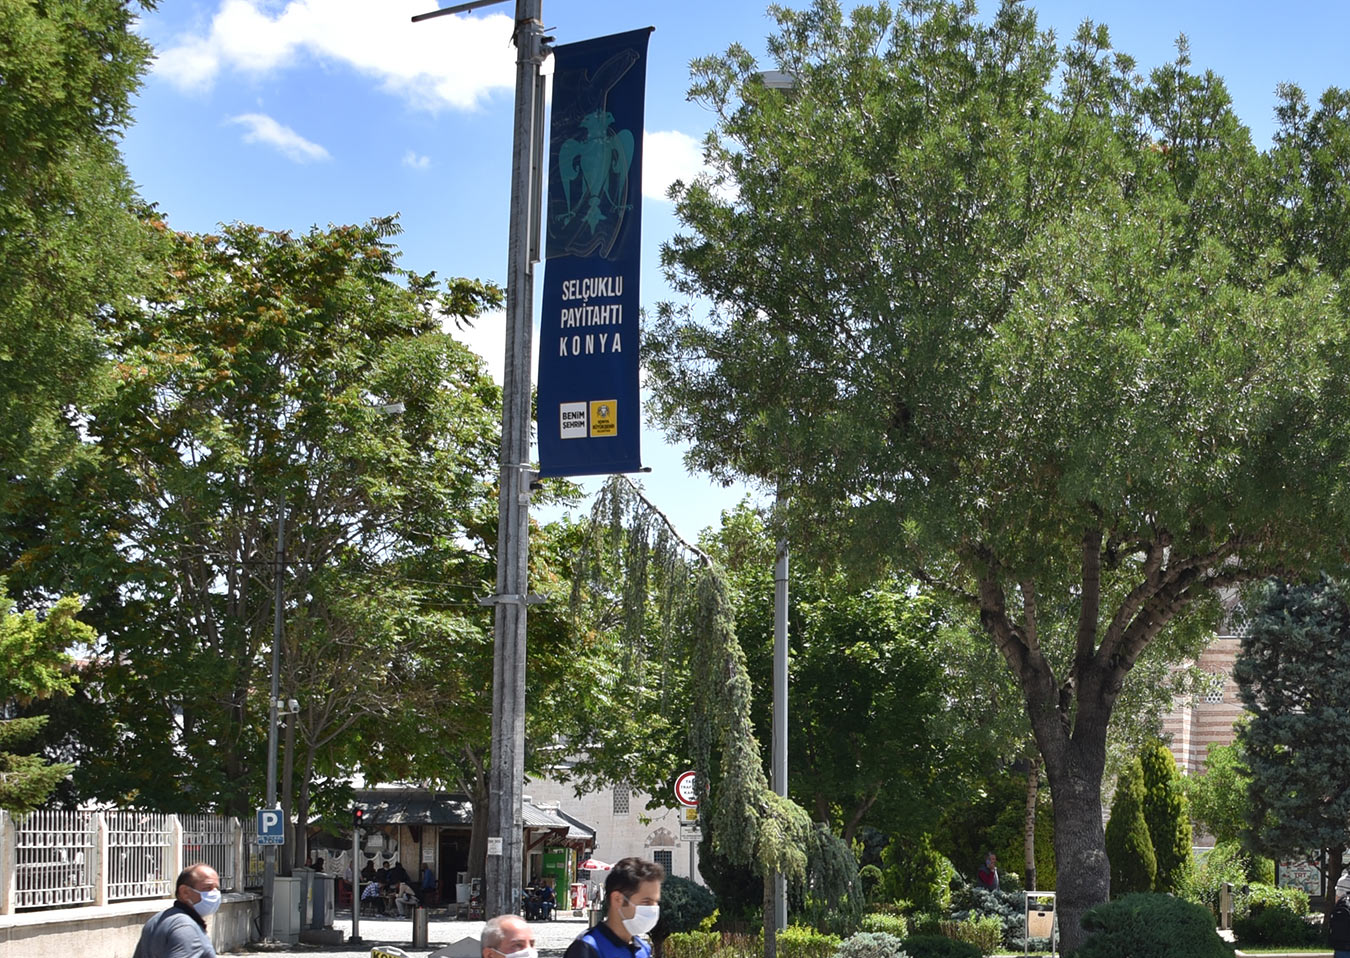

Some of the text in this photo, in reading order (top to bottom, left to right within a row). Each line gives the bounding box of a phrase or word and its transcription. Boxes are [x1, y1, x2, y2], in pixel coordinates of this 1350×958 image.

[562, 276, 623, 302] SELÇUKLU
[561, 303, 622, 328] PAYİTAHTI
[560, 333, 621, 356] KONYA
[262, 812, 278, 833] P
